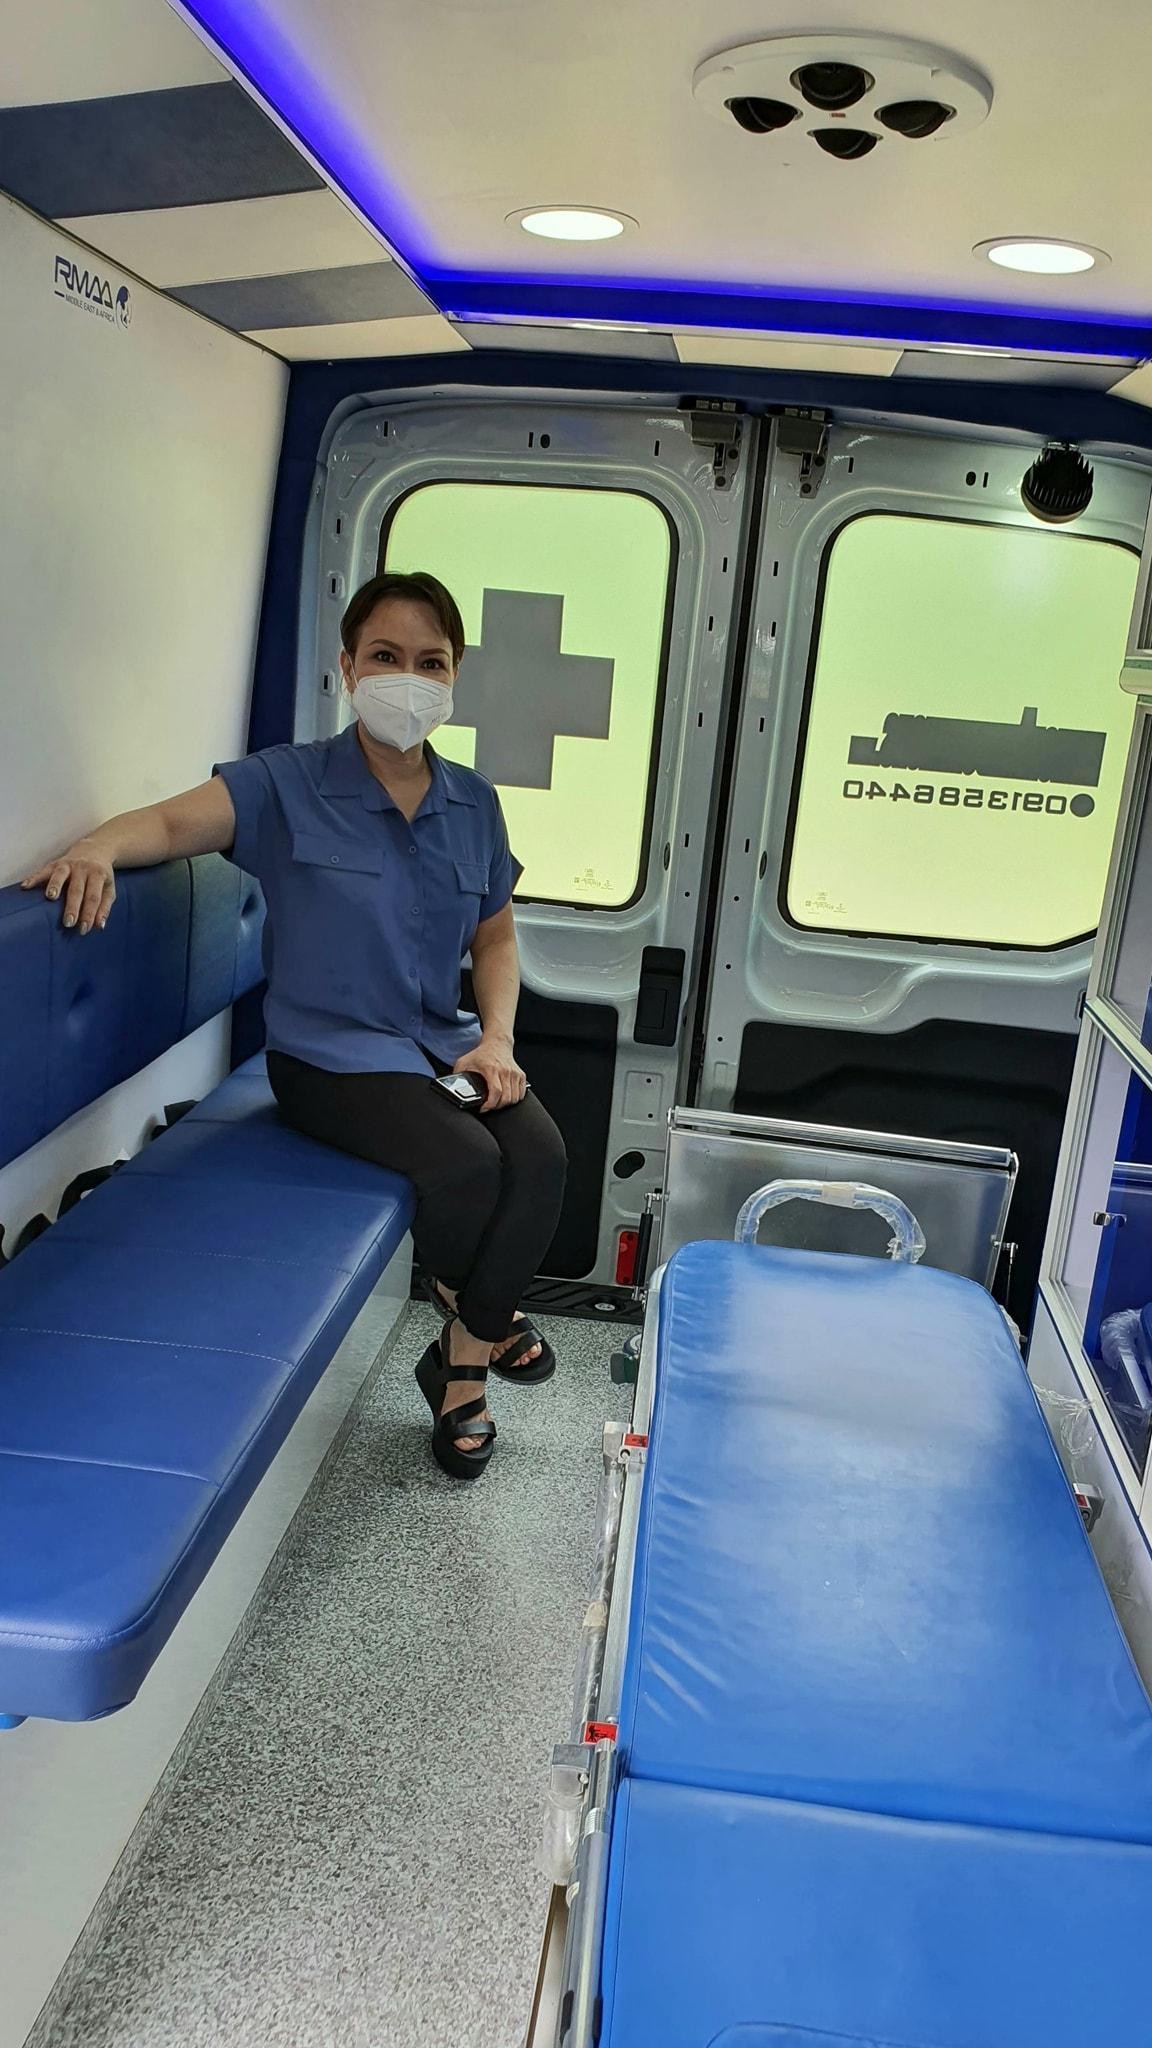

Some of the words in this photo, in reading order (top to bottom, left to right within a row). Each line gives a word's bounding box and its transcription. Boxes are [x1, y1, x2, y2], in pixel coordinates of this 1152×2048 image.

[54, 255, 114, 309] RMAA
[66, 294, 83, 310] MIDDLE
[83, 302, 96, 314] EAST
[100, 309, 115, 322] AFRICA
